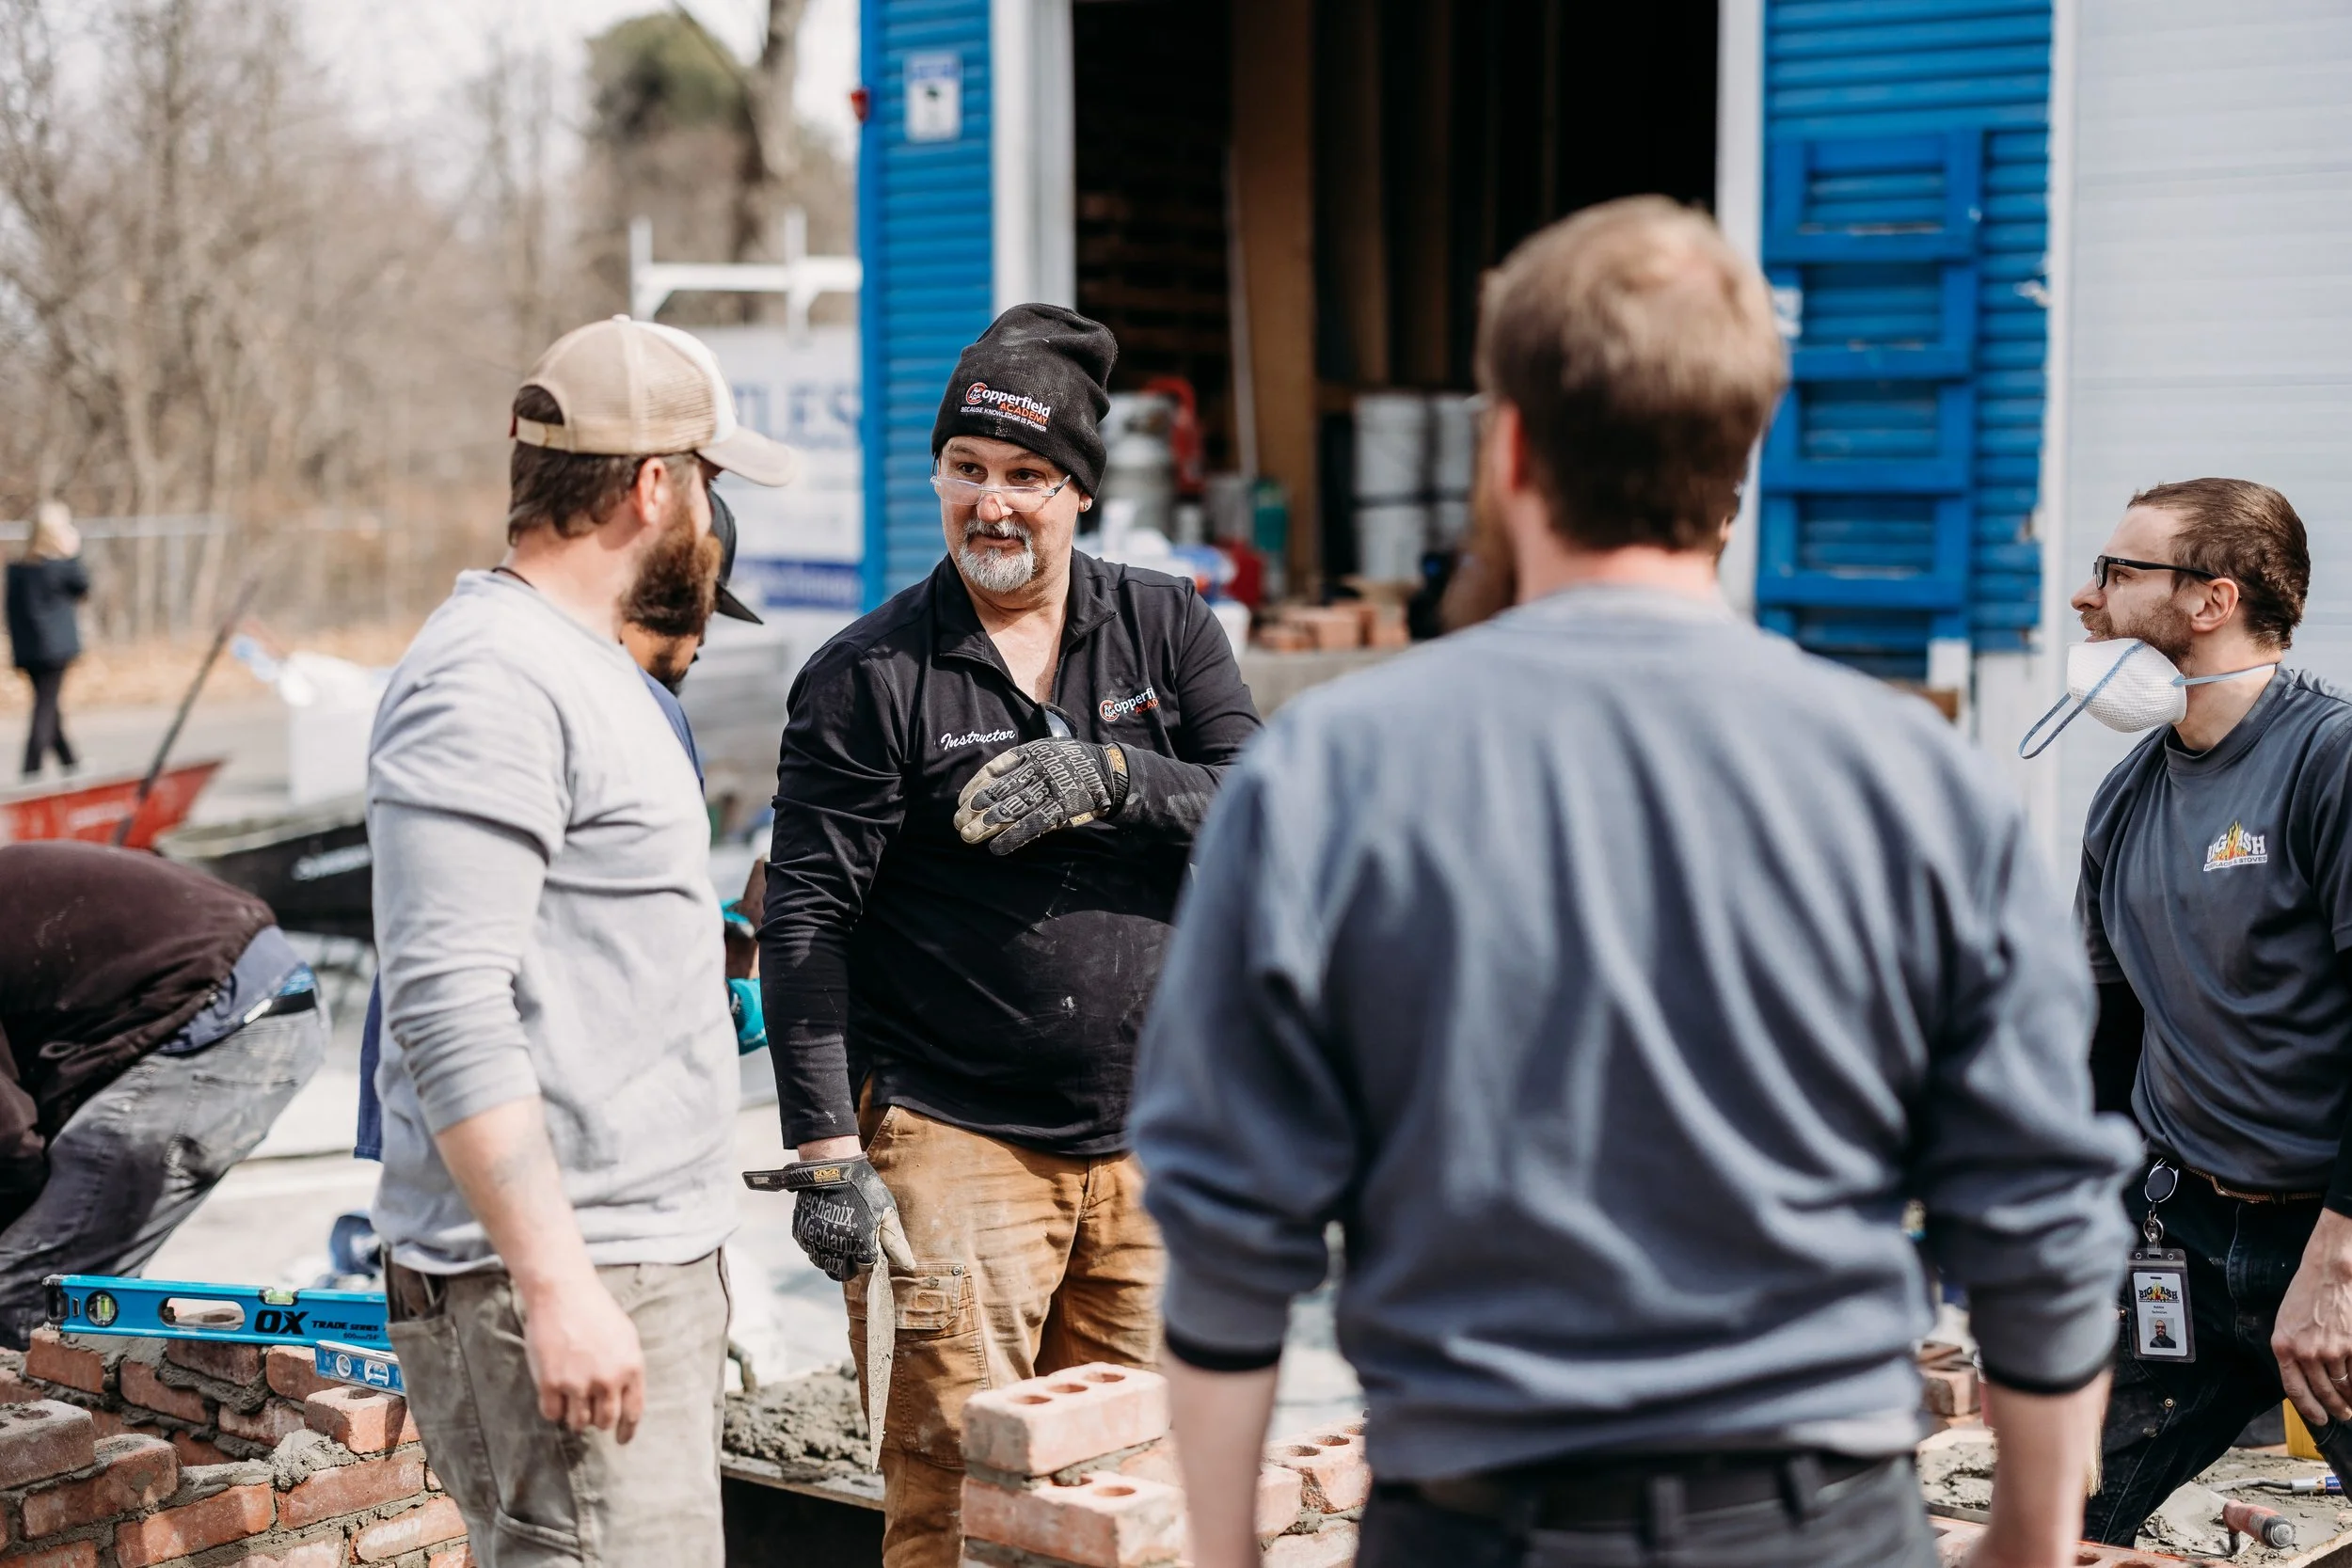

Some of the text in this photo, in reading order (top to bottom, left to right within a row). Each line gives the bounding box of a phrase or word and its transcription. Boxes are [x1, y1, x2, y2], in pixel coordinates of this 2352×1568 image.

[966, 382, 1050, 418] Copperfield
[984, 407, 1021, 422] KNOWLEDGE
[1021, 417, 1027, 425] IS
[1026, 419, 1047, 433] POWER
[999, 403, 1049, 425] ACADEMY
[940, 729, 1016, 751] Instructor
[2138, 1286, 2178, 1299] BIG ASH
[254, 1309, 310, 1336] OX
[311, 1321, 378, 1332] TRADE SERIES
